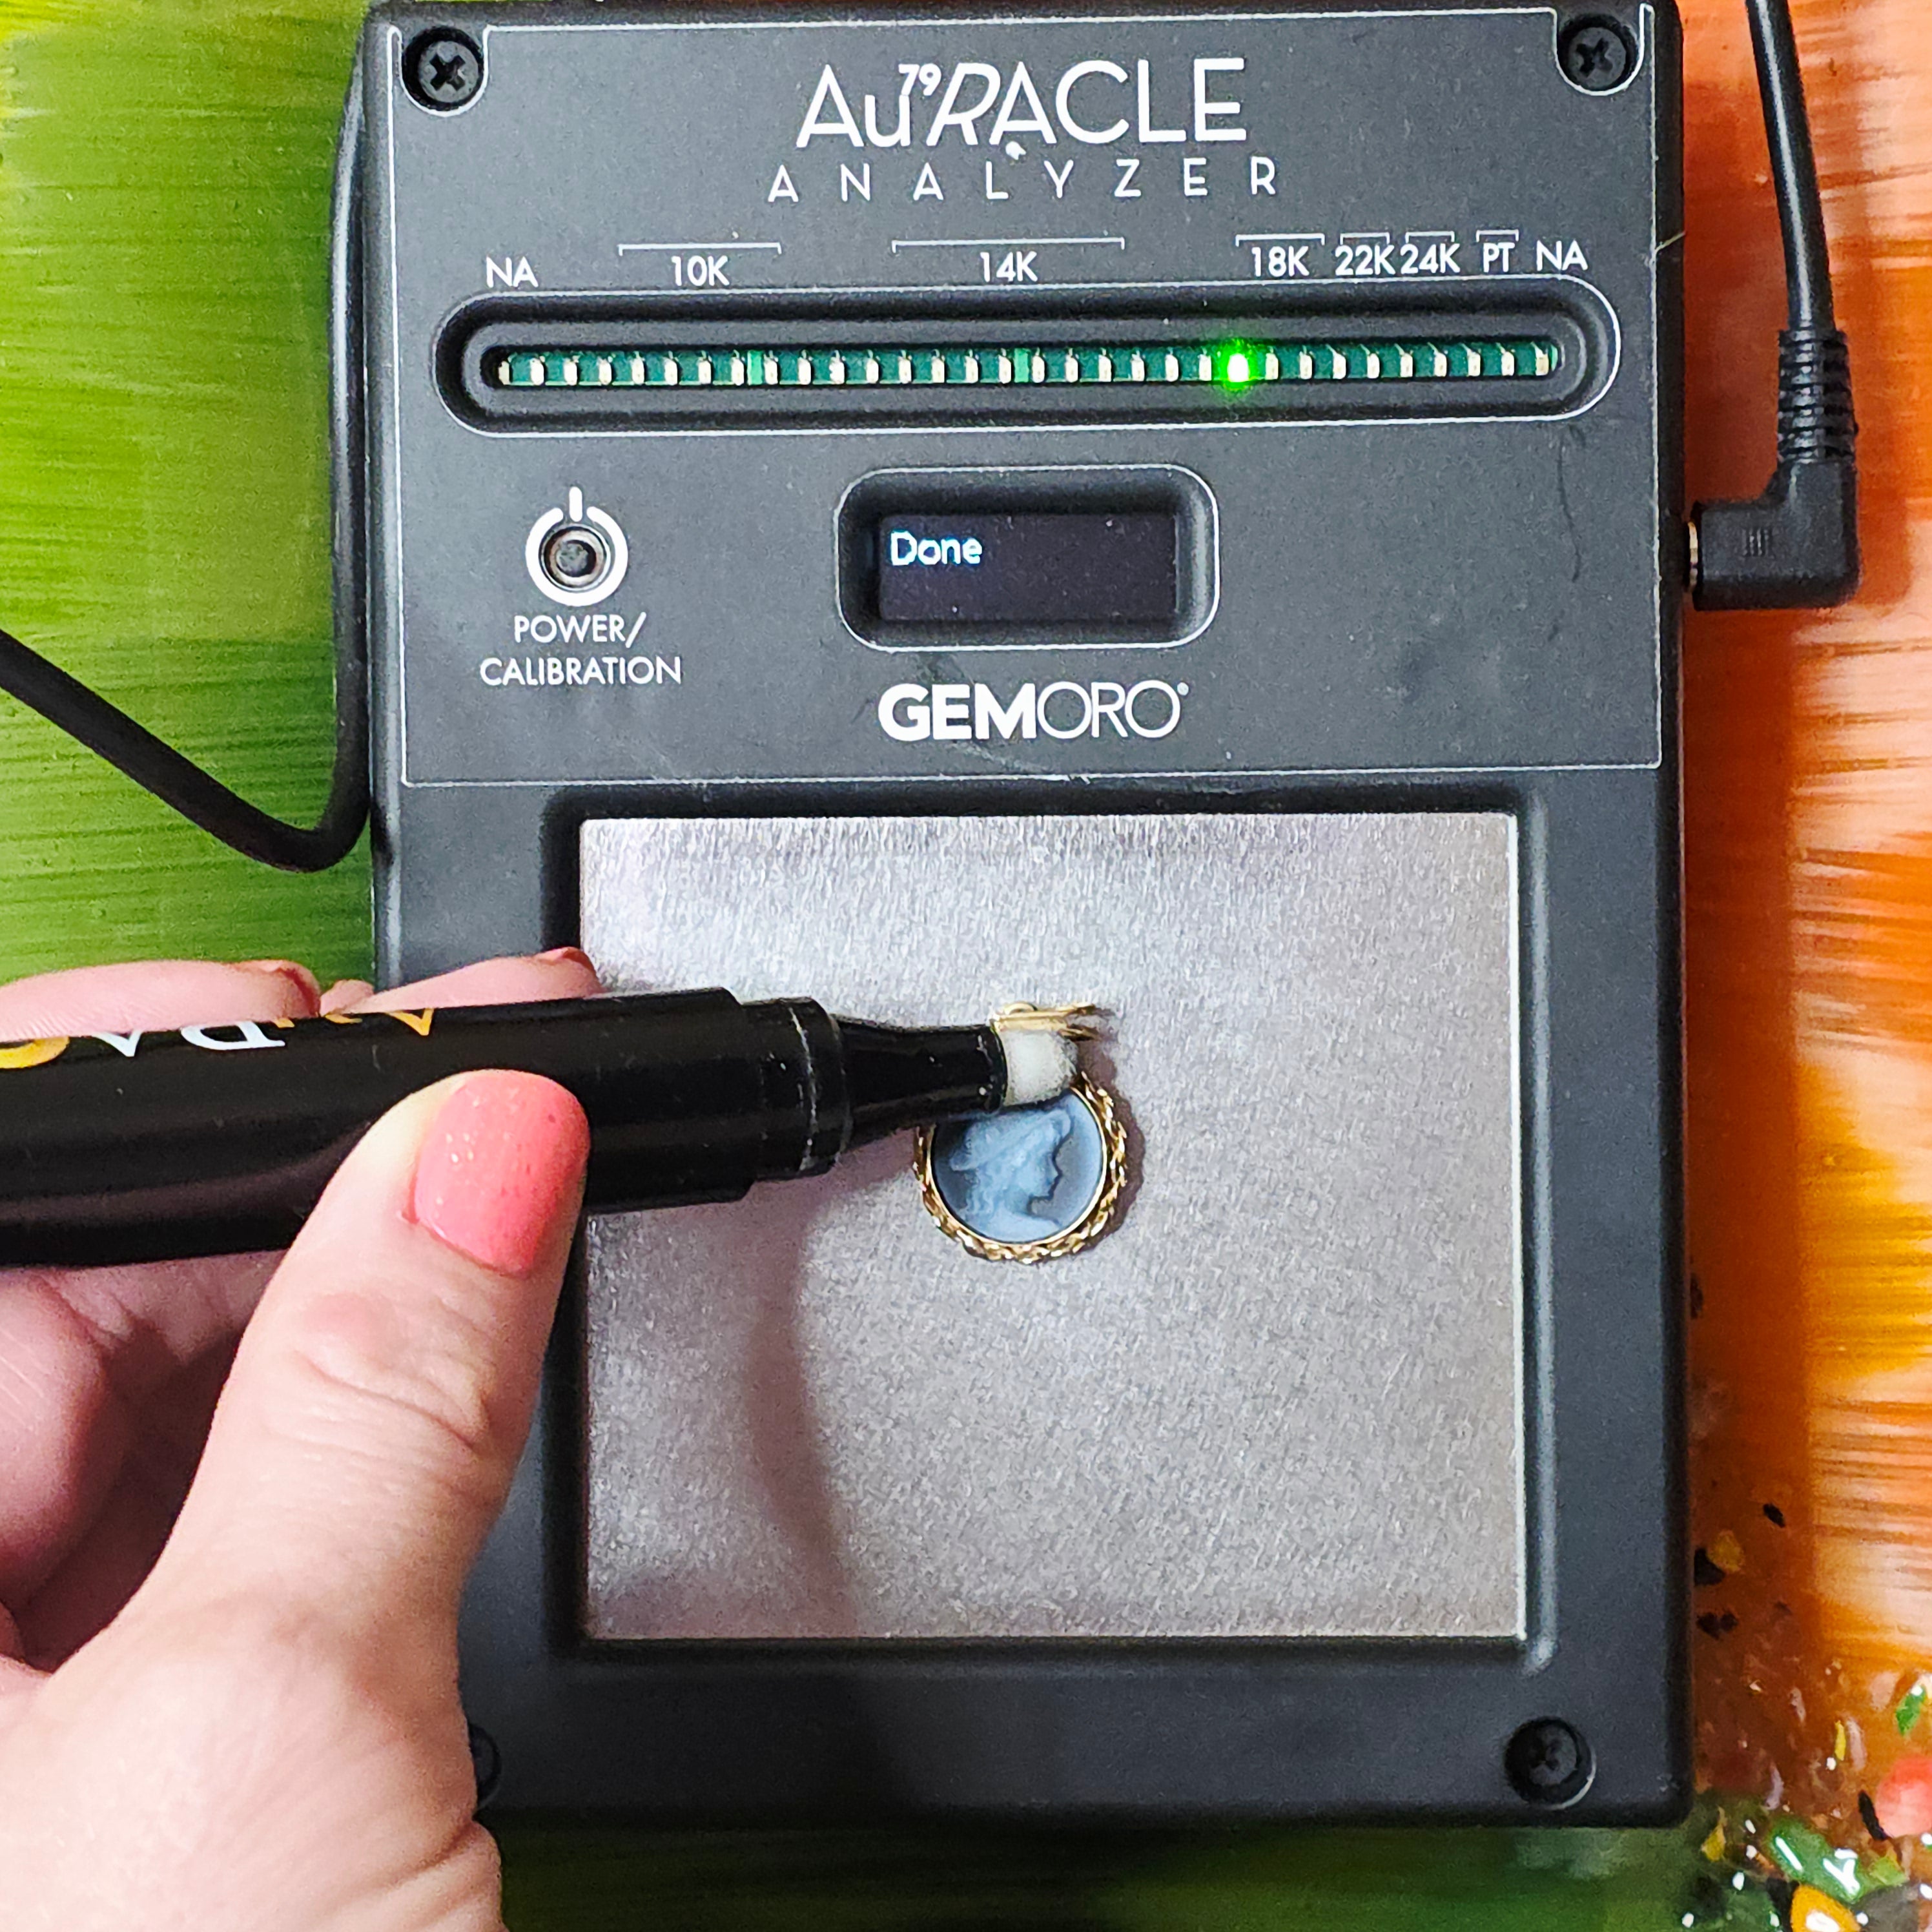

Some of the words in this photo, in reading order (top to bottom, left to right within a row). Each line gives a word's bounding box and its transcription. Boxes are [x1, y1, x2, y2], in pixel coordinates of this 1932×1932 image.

[768, 156, 1276, 203] ANALYZER
[485, 256, 539, 289] NA
[670, 255, 730, 287] 10K
[979, 251, 1039, 283] 14K
[1251, 245, 1310, 278] 18K
[1334, 244, 1396, 276] 22K
[1399, 243, 1461, 275] 24K
[1483, 242, 1516, 273] PT
[1536, 240, 1588, 272] NA
[890, 530, 983, 566] Done
[514, 611, 647, 648] POWER/
[479, 655, 682, 686] CALIBRATION
[878, 679, 1182, 742] GEMORO
